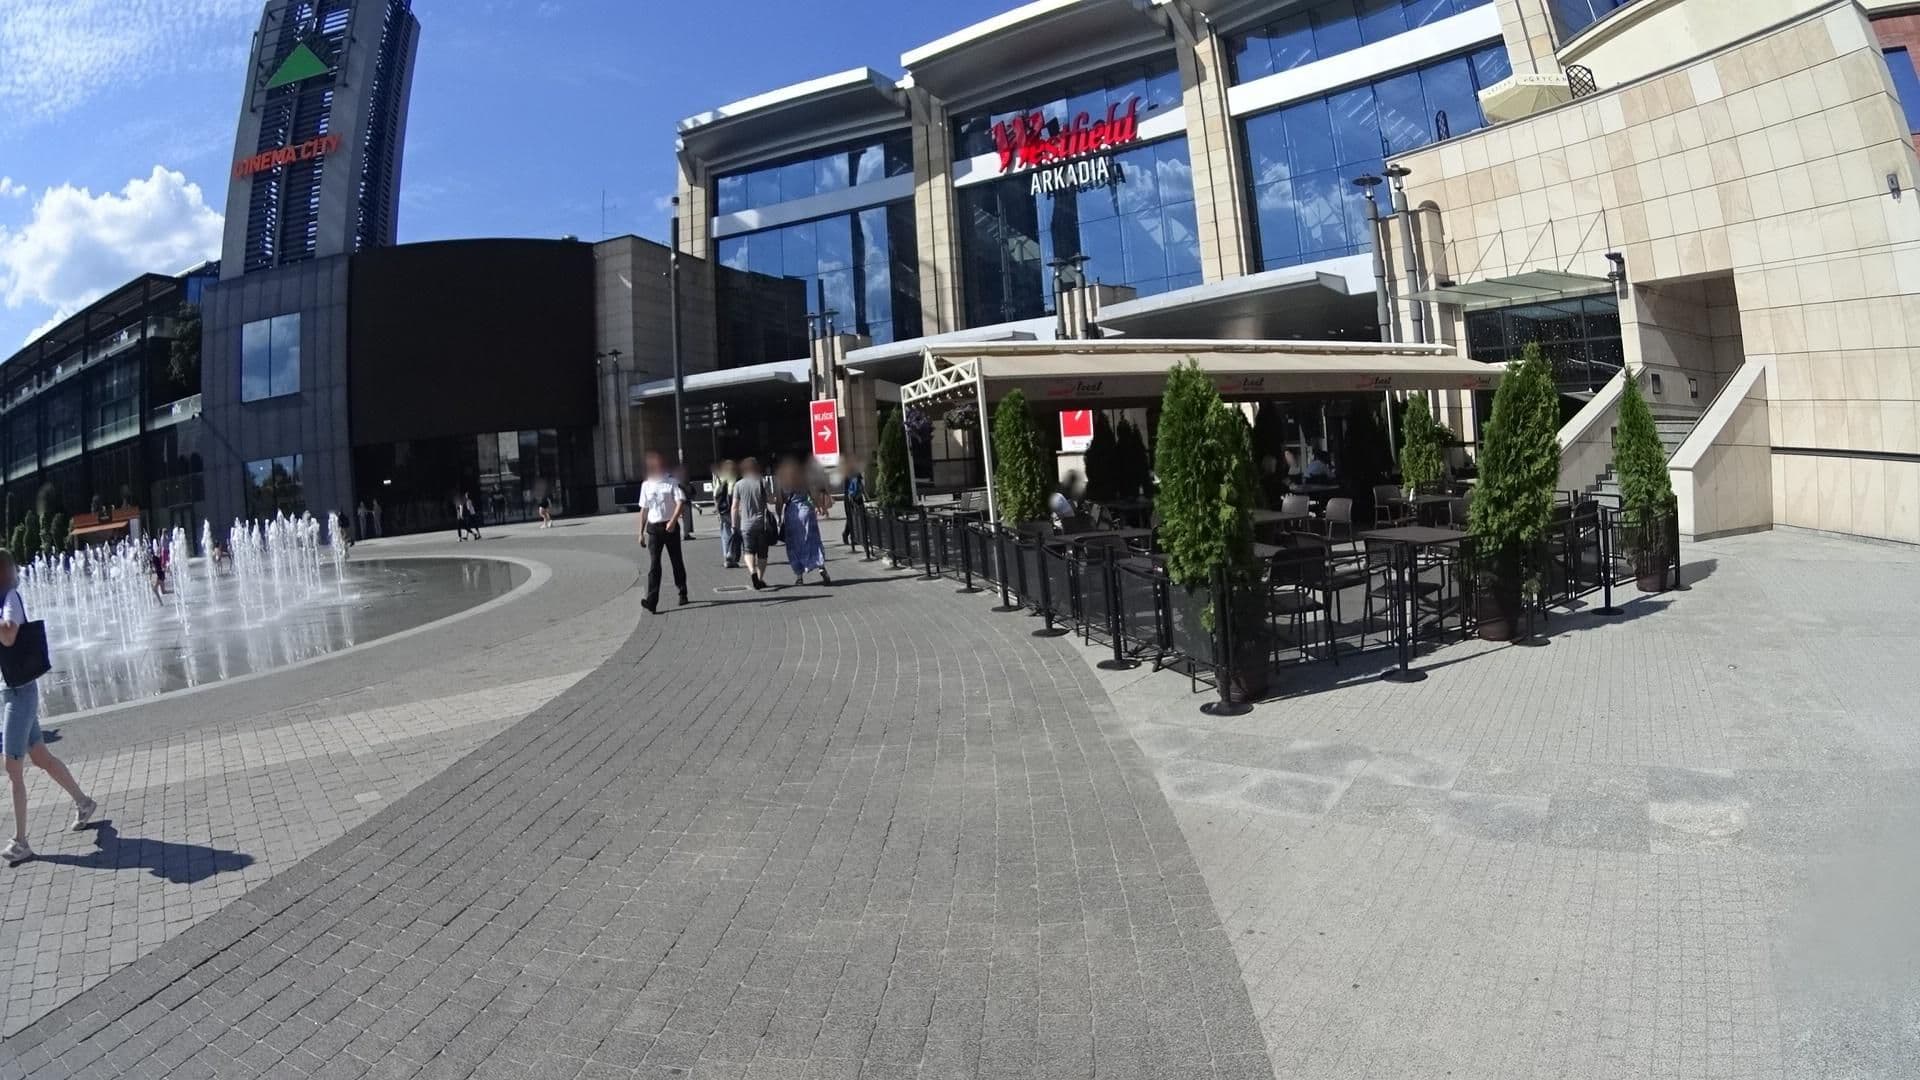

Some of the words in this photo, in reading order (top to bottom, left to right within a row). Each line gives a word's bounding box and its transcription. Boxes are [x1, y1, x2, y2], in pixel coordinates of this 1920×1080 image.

[233, 146, 297, 179] CINEMA
[301, 134, 341, 161] CITY
[992, 97, 1140, 173] Westfield
[1030, 156, 1109, 196] ARKADIA
